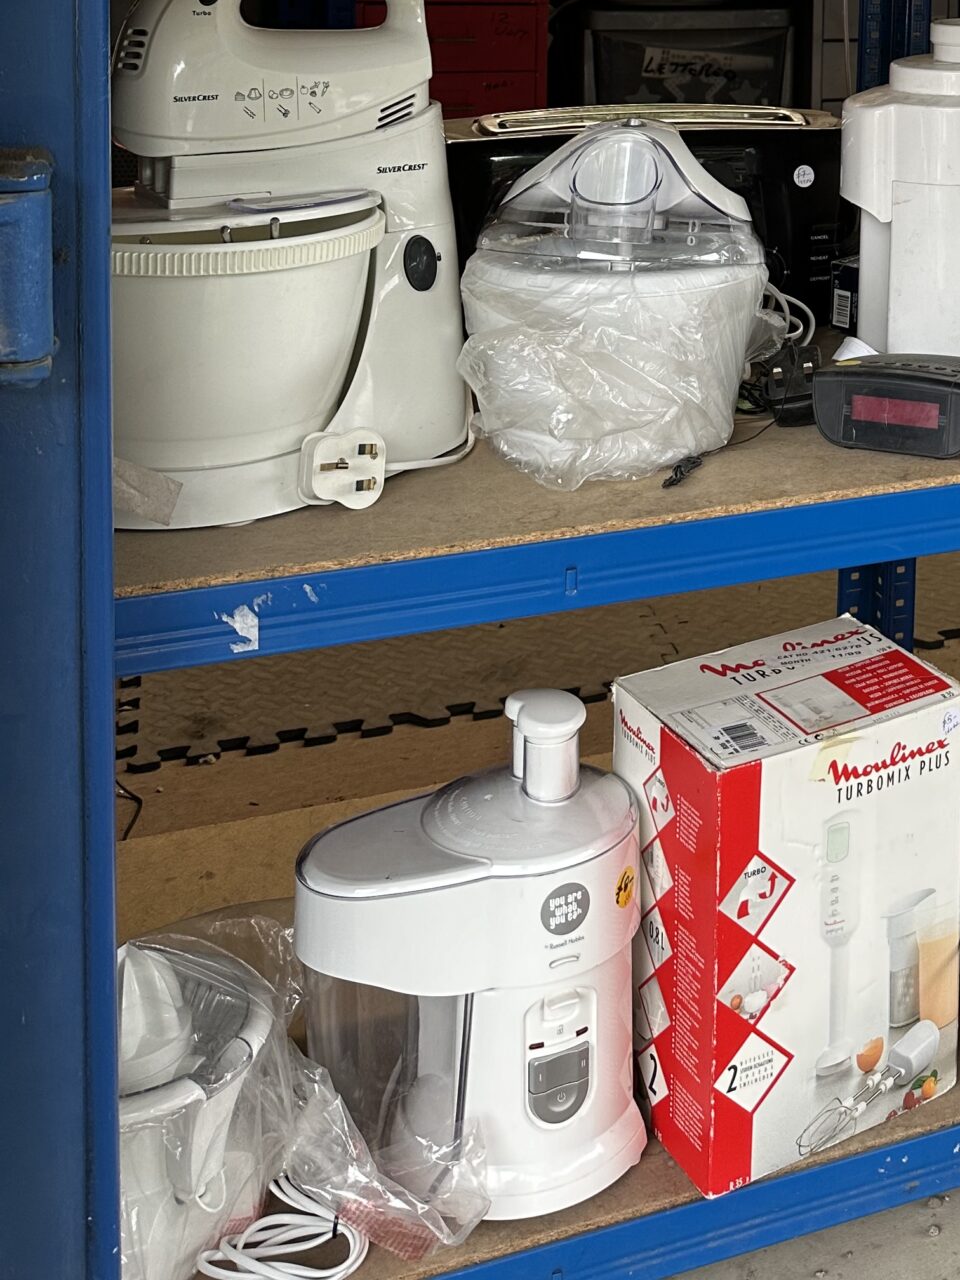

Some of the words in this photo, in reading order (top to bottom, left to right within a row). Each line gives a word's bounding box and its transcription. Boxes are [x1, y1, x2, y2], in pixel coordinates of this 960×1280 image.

[780, 657, 812, 666] MONTH
[619, 708, 656, 754] Moulinex
[828, 737, 950, 785] Moulinex
[836, 765, 911, 803] TURBOMIX
[919, 750, 950, 775] PLUS
[743, 866, 767, 880] TURBO
[549, 896, 566, 911] you
[567, 890, 582, 903] are
[549, 913, 566, 930] you
[648, 1052, 658, 1097] 2
[725, 1063, 738, 1095] 2
